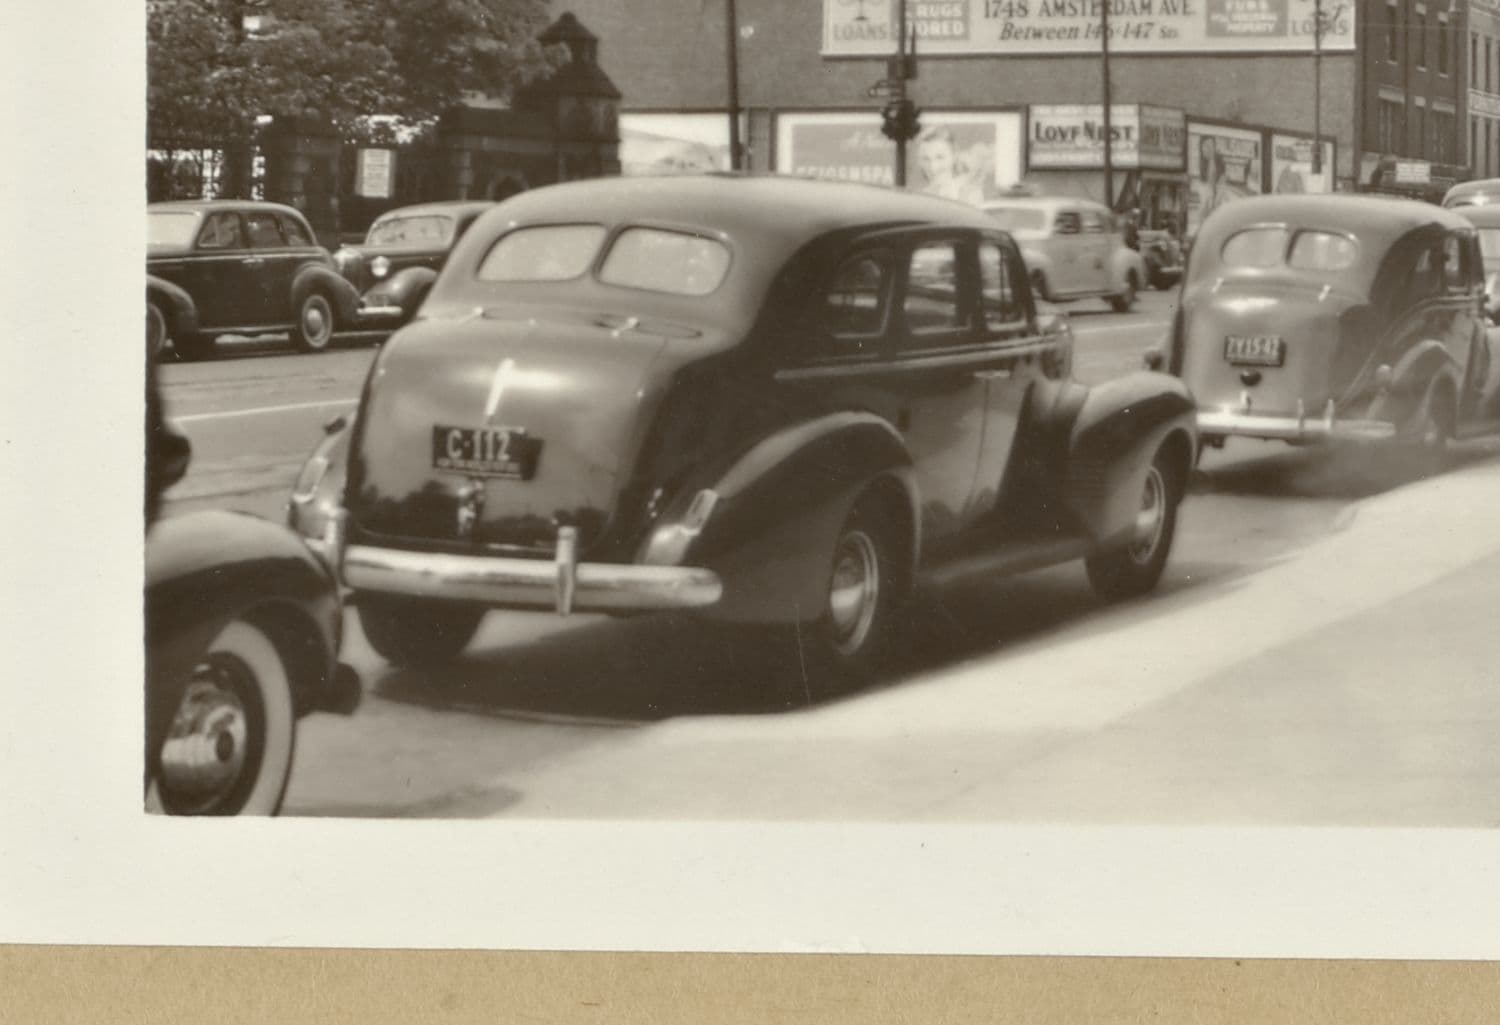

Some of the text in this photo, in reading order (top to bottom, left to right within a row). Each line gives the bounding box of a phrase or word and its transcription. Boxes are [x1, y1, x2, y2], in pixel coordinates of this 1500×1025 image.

[916, 3, 963, 18] RUGS
[1224, 0, 1269, 12] FURS
[833, 23, 889, 41] LOANS
[896, 20, 965, 37] TORED
[998, 21, 1080, 42] Between
